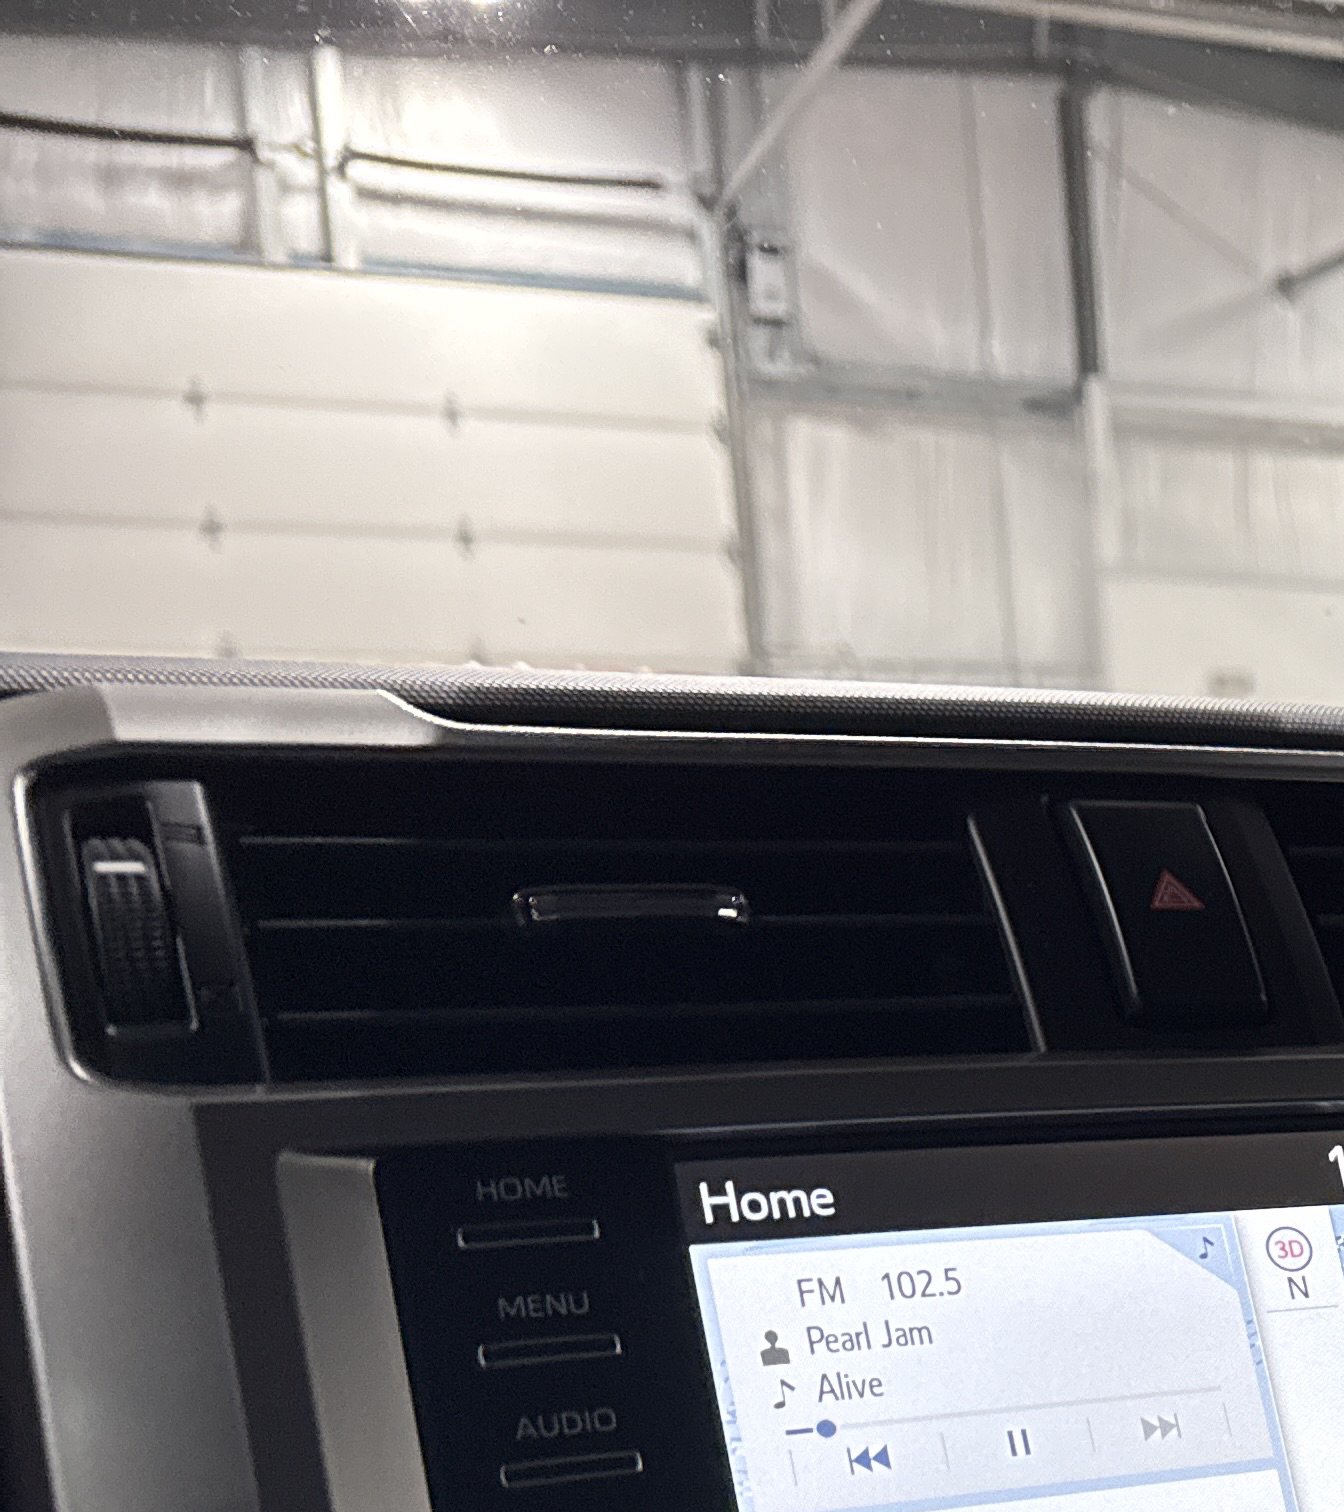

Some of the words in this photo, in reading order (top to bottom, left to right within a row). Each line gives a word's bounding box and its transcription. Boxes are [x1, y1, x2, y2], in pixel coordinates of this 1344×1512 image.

[476, 1174, 568, 1201] HOME
[699, 1179, 836, 1224] Home
[1274, 1238, 1304, 1260] 3D
[796, 1276, 846, 1308] FM
[881, 1266, 963, 1302] 102.5
[1287, 1275, 1309, 1300] N
[498, 1290, 590, 1319] MENU
[806, 1321, 872, 1356] Pearl
[882, 1320, 934, 1350] Jam
[817, 1373, 885, 1404] Alive
[516, 1407, 618, 1440] AUDIO
